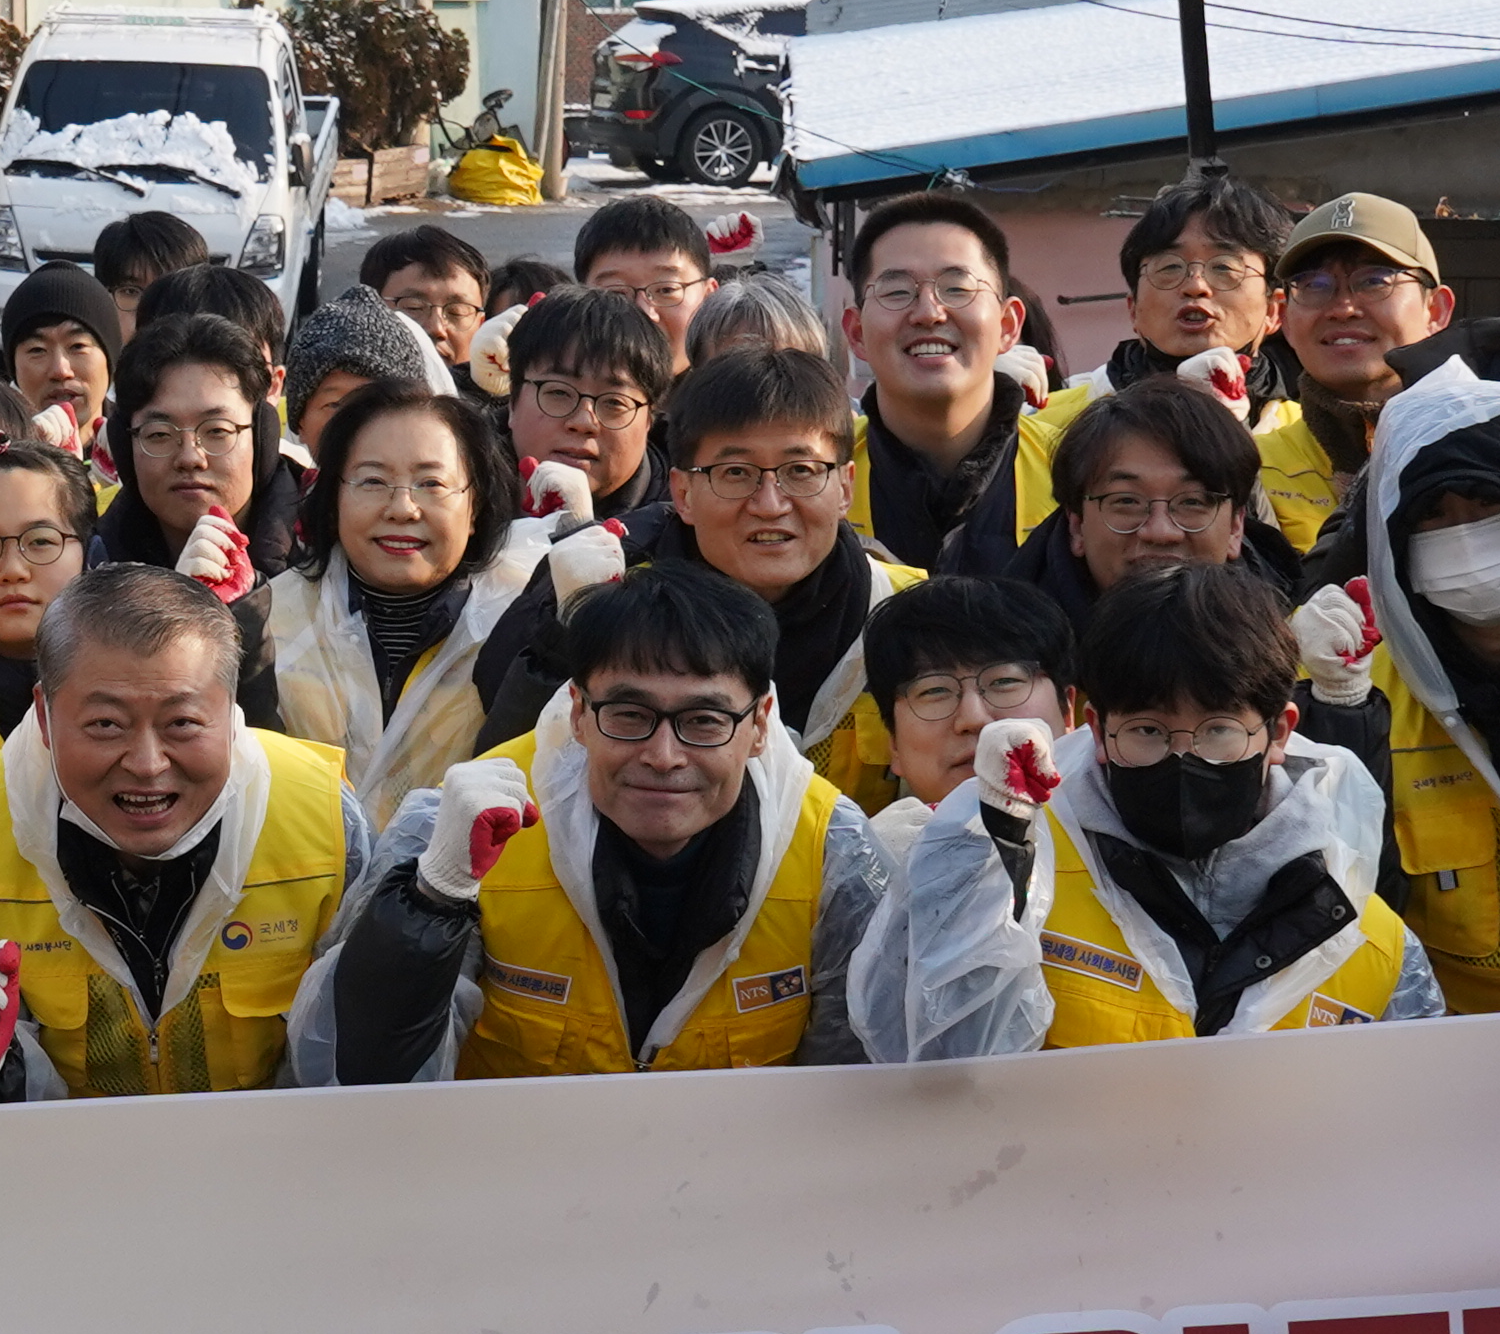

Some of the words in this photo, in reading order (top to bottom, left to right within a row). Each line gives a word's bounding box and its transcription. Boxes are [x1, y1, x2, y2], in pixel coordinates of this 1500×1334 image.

[259, 918, 299, 936] 국세청
[24, 939, 72, 953] 사회봉사단
[1041, 939, 1078, 962] 국세청
[1078, 950, 1140, 982] 사회봉사단
[507, 973, 567, 997] 사회봉사단
[740, 985, 769, 1001] NTS
[1311, 1006, 1338, 1026] NTS
